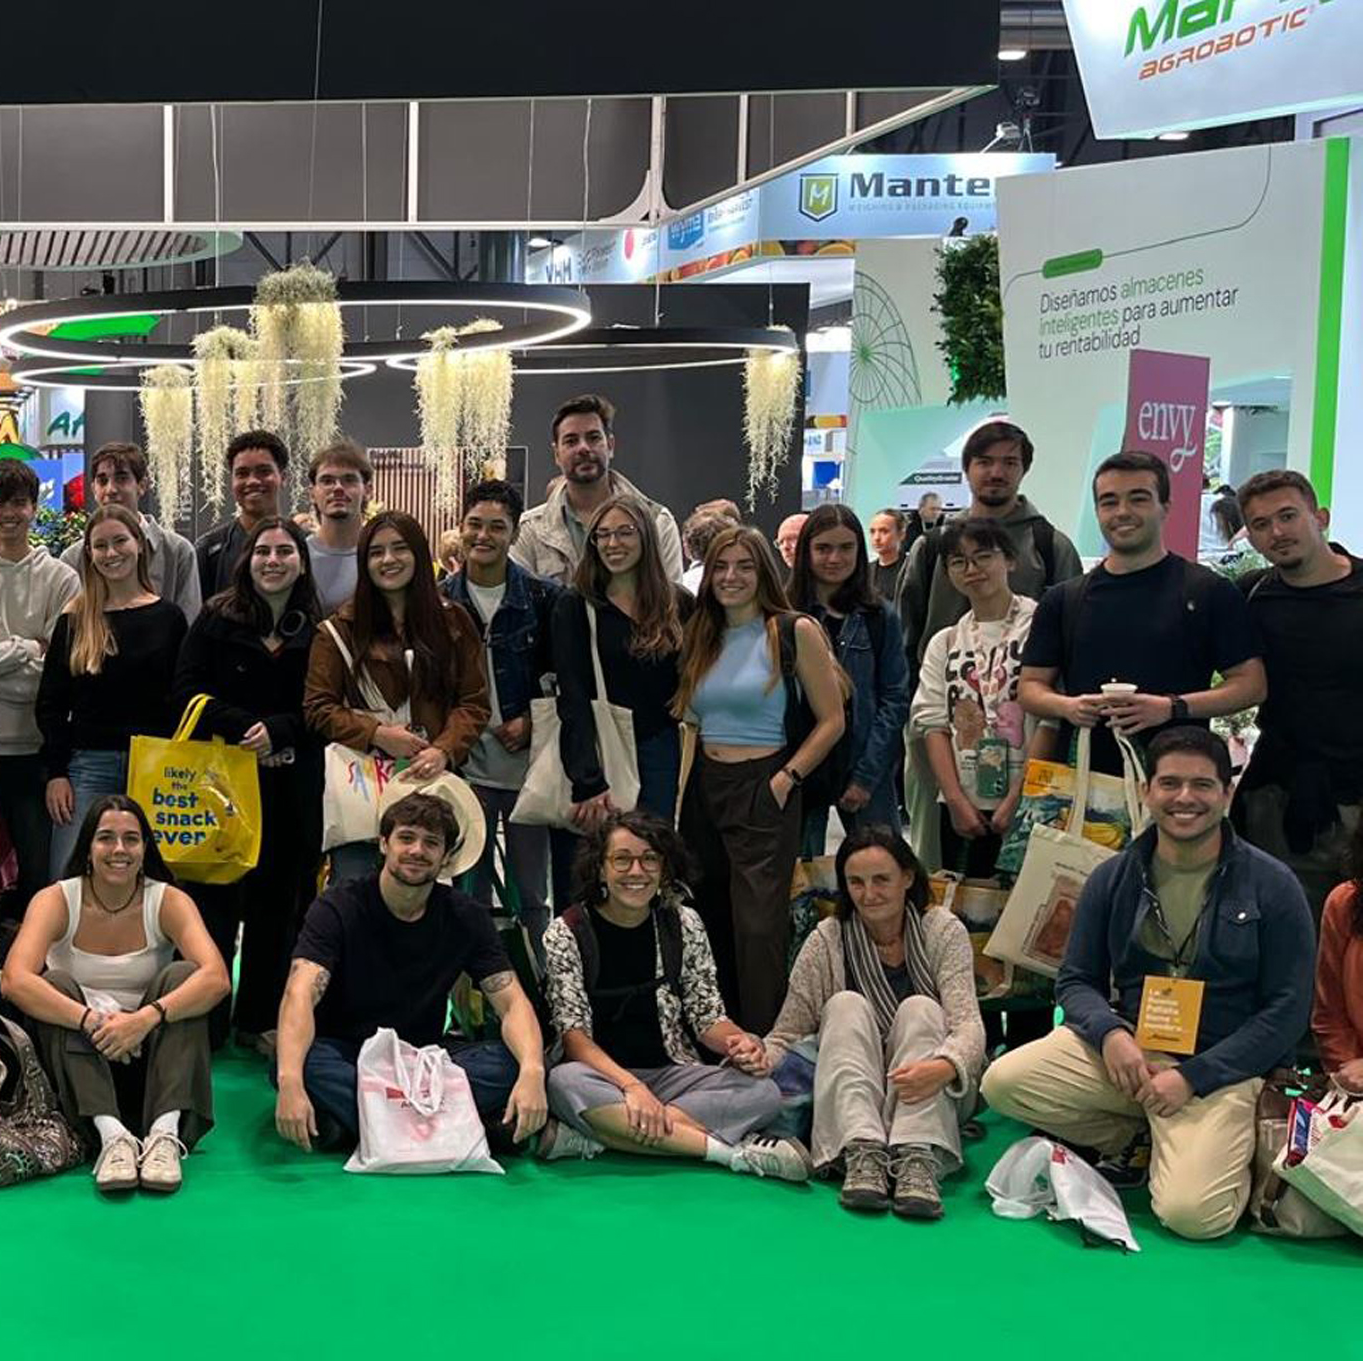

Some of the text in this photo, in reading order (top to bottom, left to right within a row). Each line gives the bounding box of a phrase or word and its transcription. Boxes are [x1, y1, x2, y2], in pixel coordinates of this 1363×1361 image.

[1040, 268, 1204, 314] Diseñamos almacenes
[1039, 287, 1239, 338] inteligentes para aumentar
[1039, 325, 1141, 359] tu rentabilidad
[1138, 400, 1198, 473] envy
[164, 767, 196, 782] likely
[152, 787, 199, 808] best
[156, 810, 216, 826] snack
